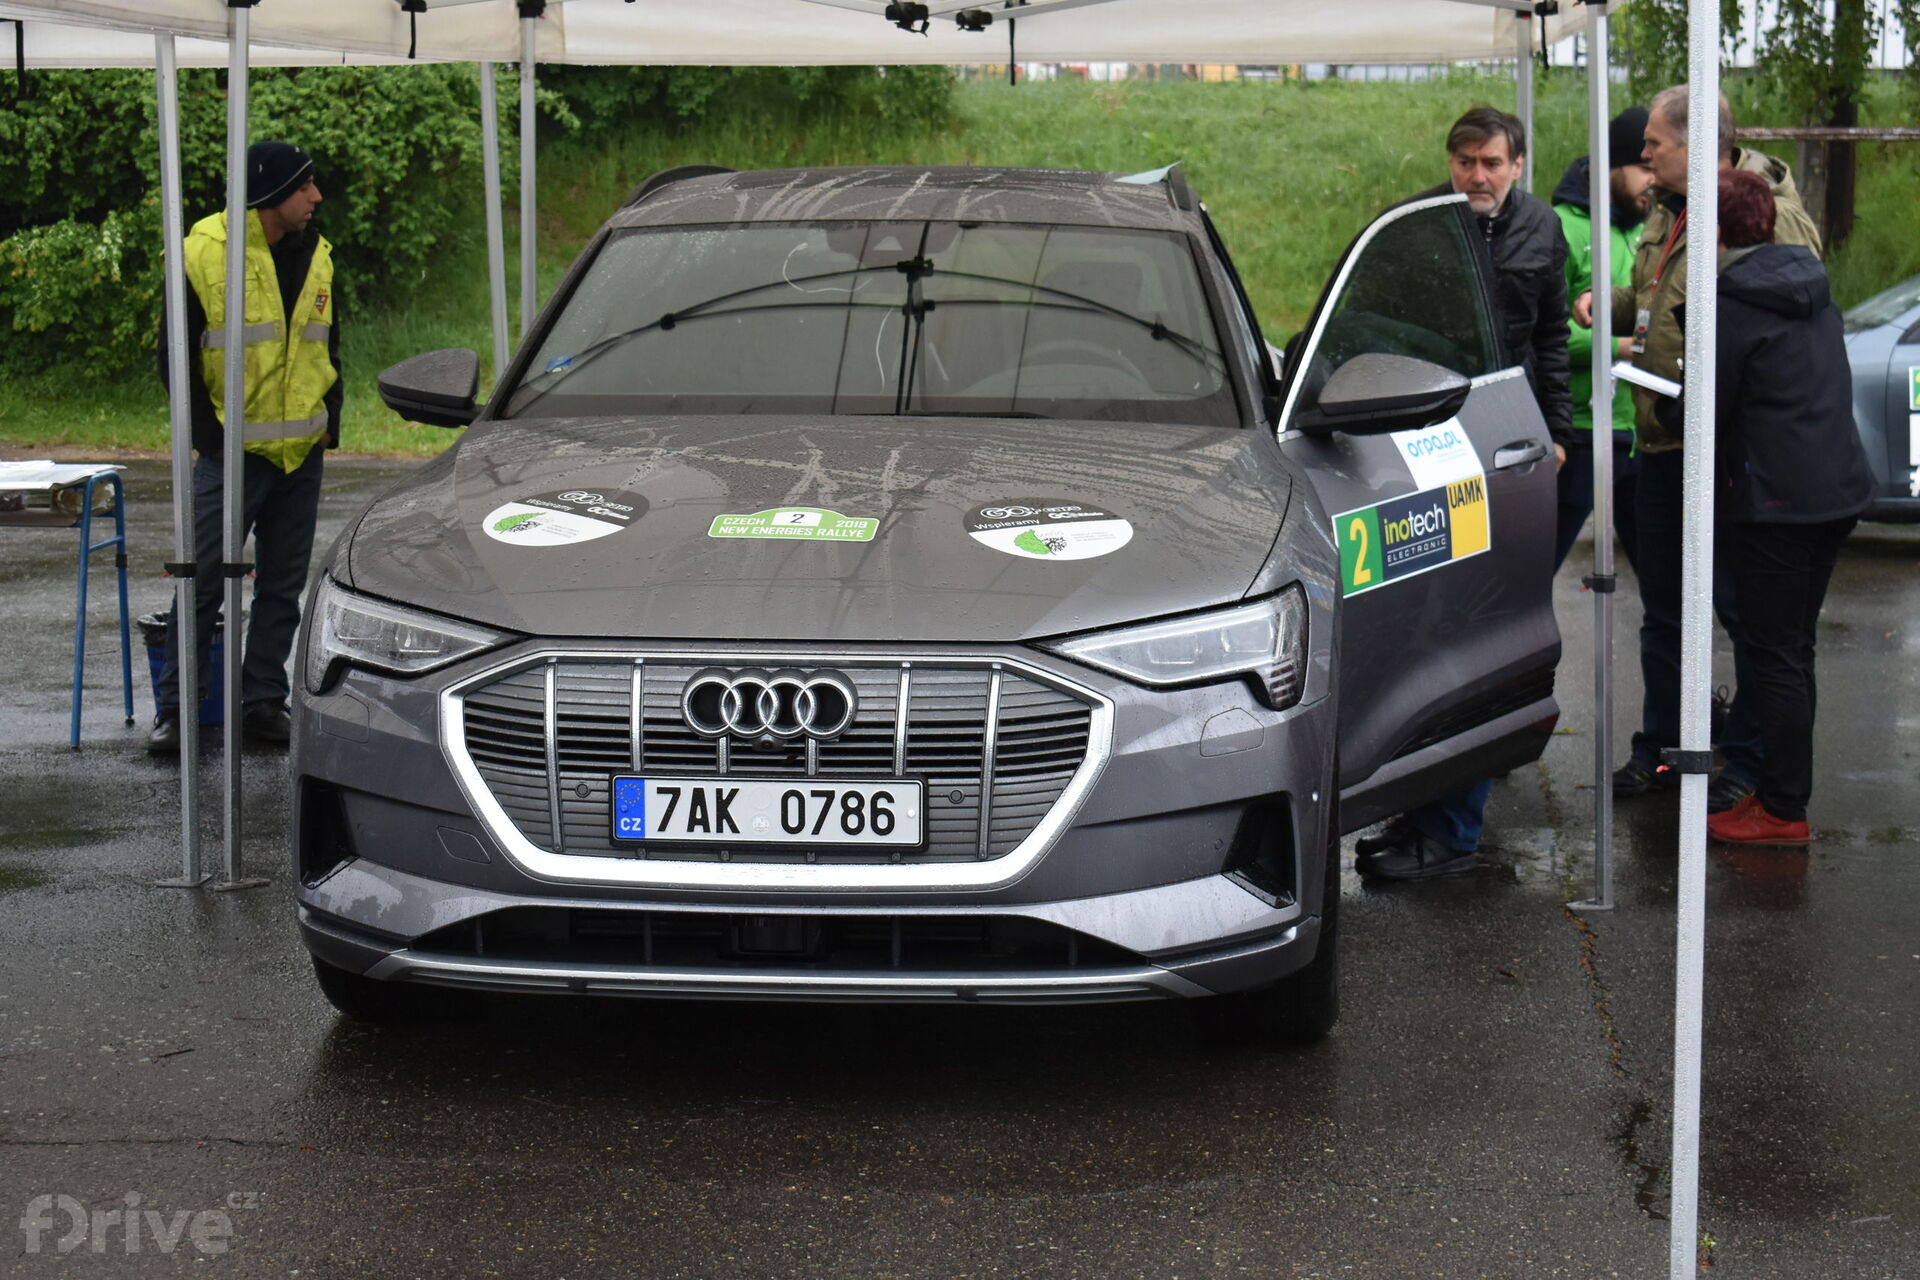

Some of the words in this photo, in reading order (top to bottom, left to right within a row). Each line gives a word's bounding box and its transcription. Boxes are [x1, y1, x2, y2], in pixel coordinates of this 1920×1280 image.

[1407, 430, 1462, 457] orpa.pl
[1449, 479, 1484, 509] UAMK
[723, 517, 766, 525] CZECH
[790, 513, 805, 524] 2
[974, 518, 1040, 530] Wspieramy
[1384, 503, 1446, 546] inotech
[719, 526, 748, 534] NEW
[751, 526, 814, 536] ENERGIES
[817, 528, 864, 538] RALLYE
[1350, 518, 1371, 586] 2
[1387, 537, 1447, 563] ELECTRONIC
[656, 786, 741, 834] 7AK
[780, 788, 896, 836] 0786
[619, 817, 642, 832] CZ
